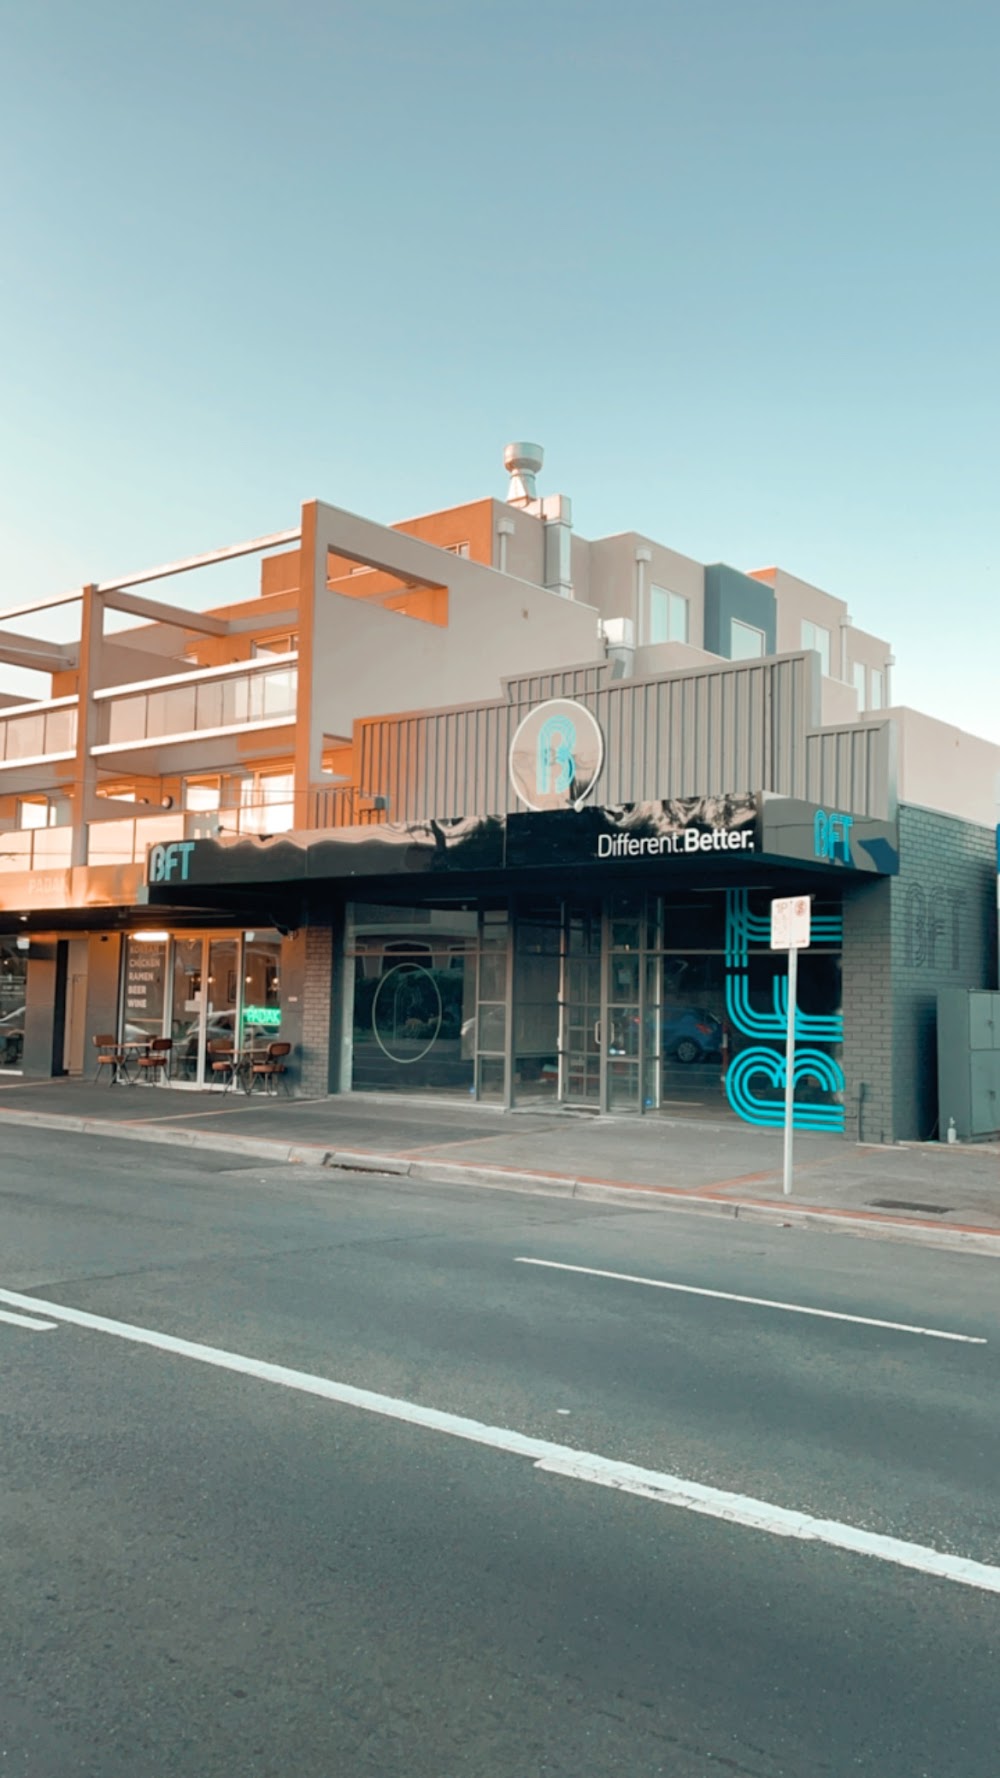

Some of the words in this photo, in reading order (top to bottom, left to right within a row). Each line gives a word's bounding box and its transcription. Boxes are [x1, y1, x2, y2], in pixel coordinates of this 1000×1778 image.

[813, 809, 854, 863] BFT
[150, 841, 195, 883] BFT
[904, 882, 967, 971] BFT
[128, 958, 160, 968] CHICKEN
[128, 971, 154, 981] RAMEN
[127, 998, 147, 1008] WINE
[128, 985, 147, 995] BEER
[725, 885, 845, 1133] BFT
